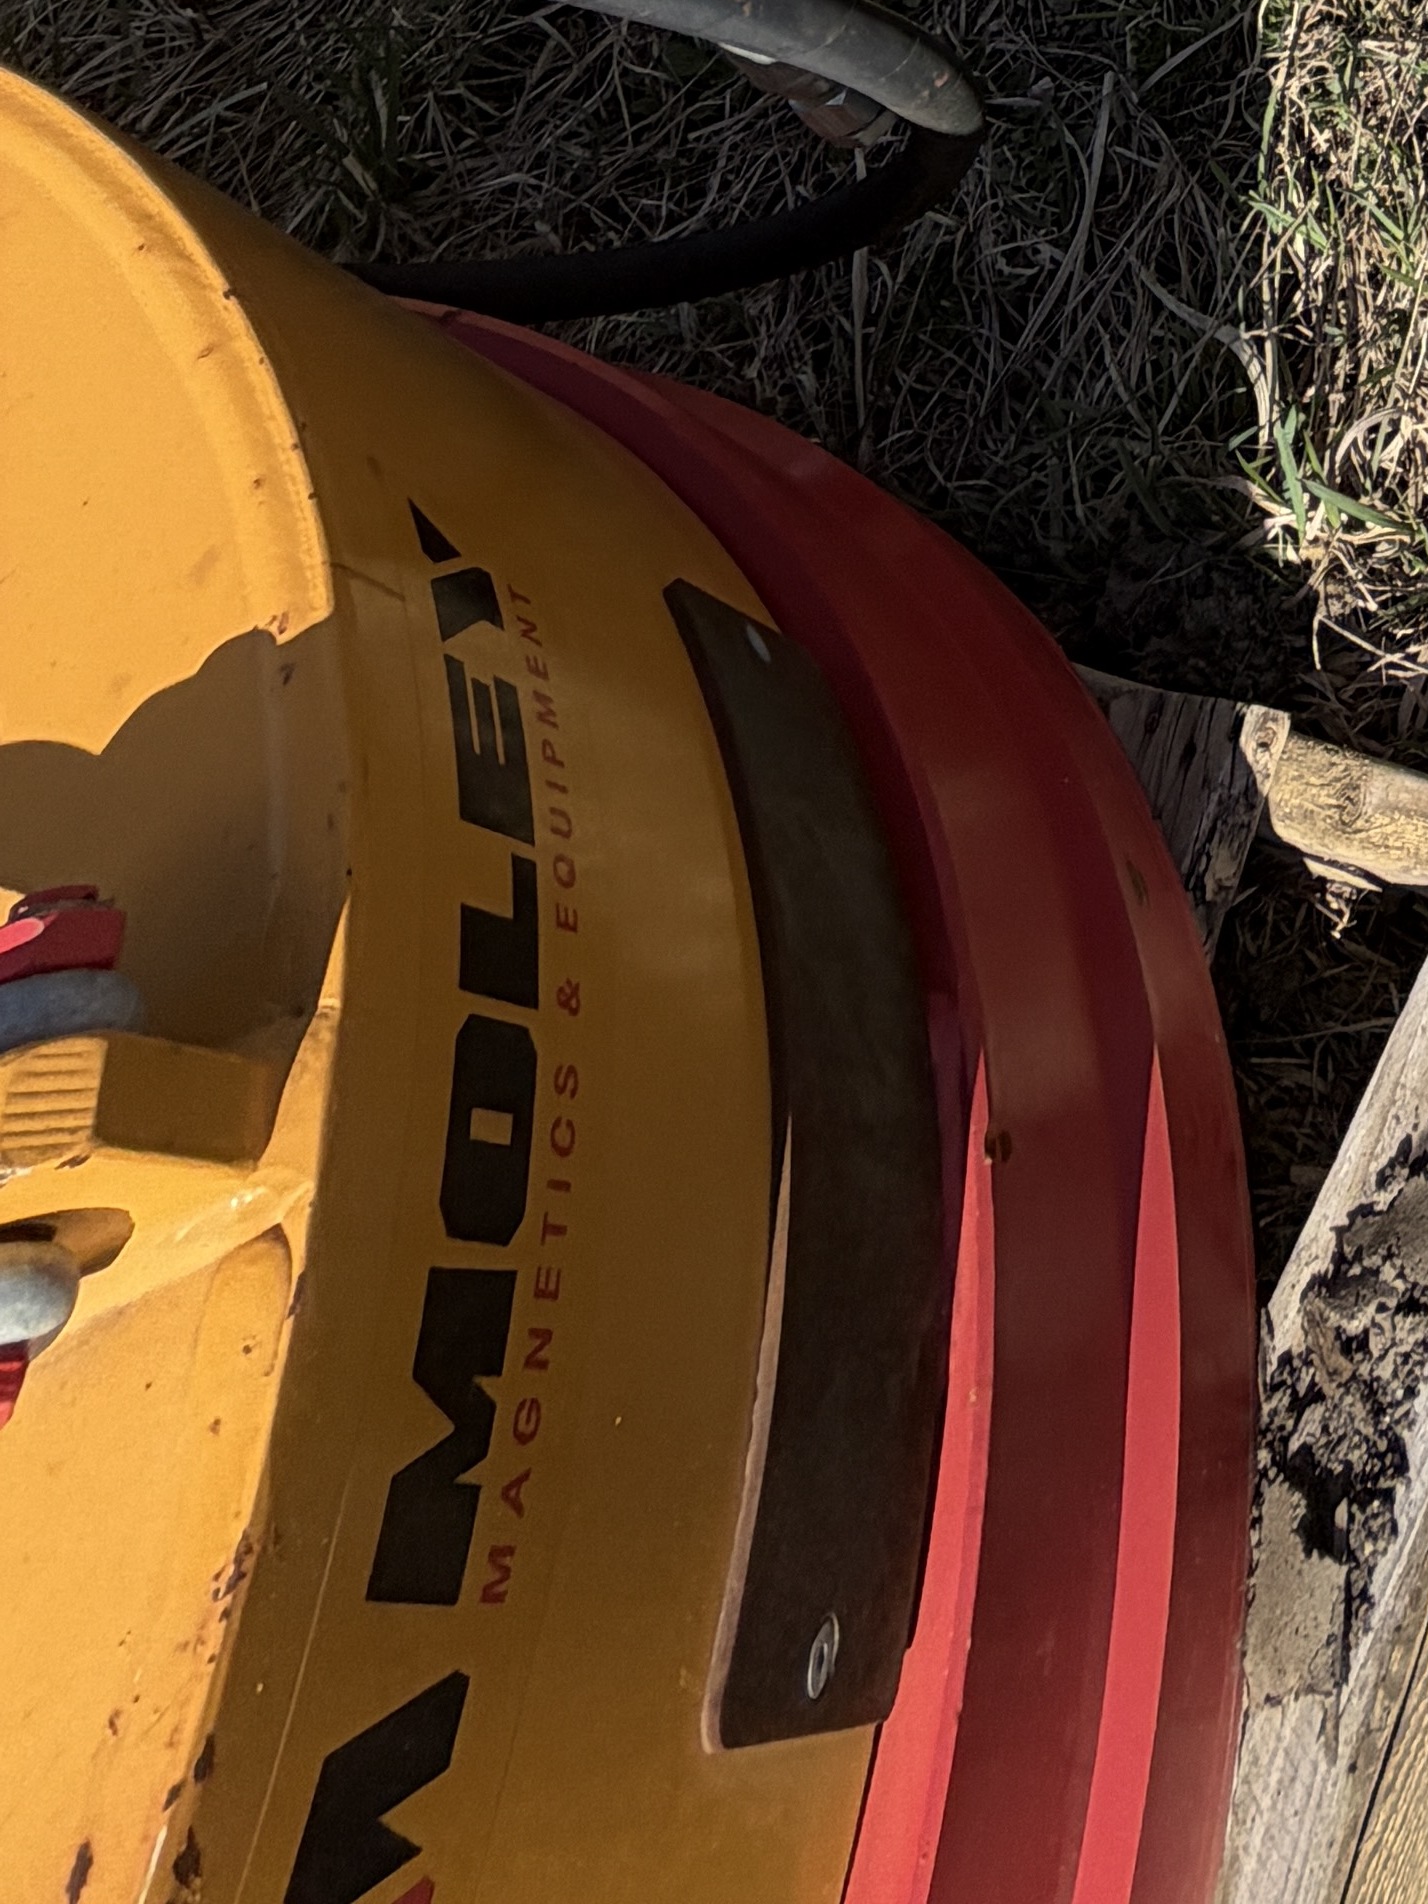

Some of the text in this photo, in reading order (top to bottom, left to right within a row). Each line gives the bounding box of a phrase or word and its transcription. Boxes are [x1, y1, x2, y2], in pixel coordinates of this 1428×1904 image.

[365, 497, 540, 1606] MOLEY
[479, 583, 582, 1605] MAGNETICS & EQUIPMENT
